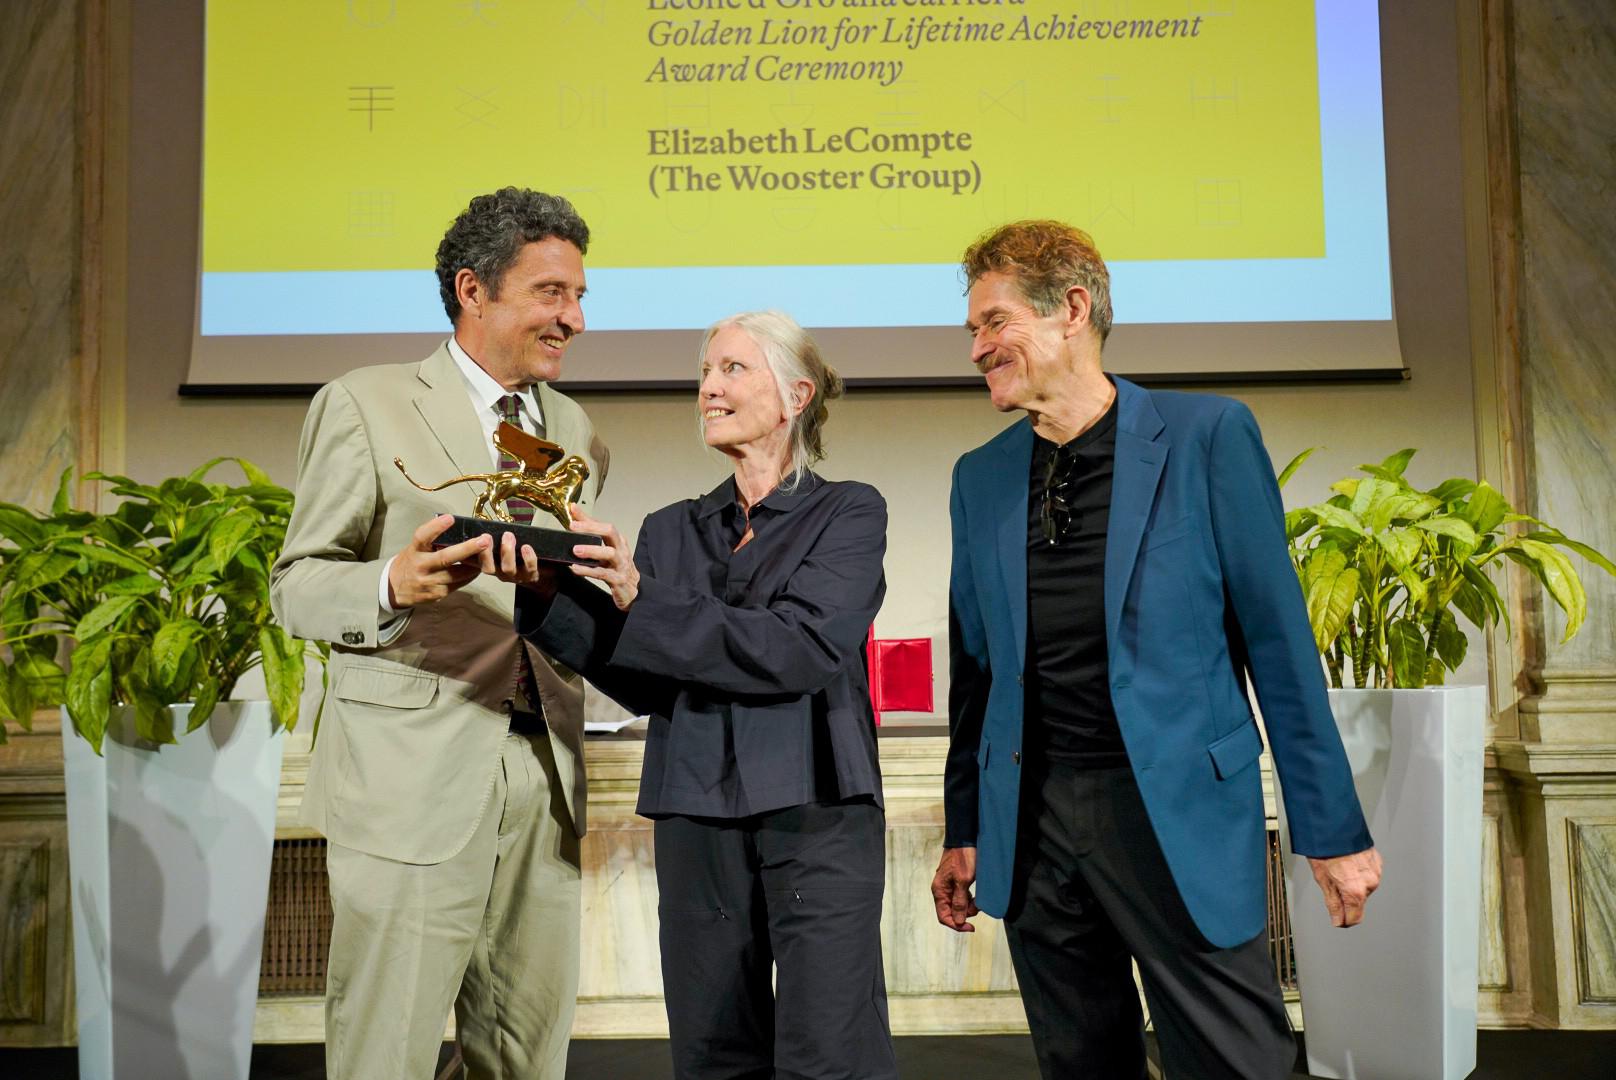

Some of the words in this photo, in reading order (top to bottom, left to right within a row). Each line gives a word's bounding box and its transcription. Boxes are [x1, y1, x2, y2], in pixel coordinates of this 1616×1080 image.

[648, 20, 752, 47] Golden
[757, 19, 828, 46] Lion
[825, 16, 878, 51] for
[880, 15, 1005, 50] Lifetime
[1008, 14, 1203, 41] Achievement
[645, 55, 750, 83] Award
[755, 55, 903, 87] Ceremony
[647, 128, 799, 156] Elizabeth
[803, 126, 973, 159] LeCompte
[648, 164, 722, 199] (The
[726, 165, 864, 192] Wooster
[869, 160, 982, 195] Group)
